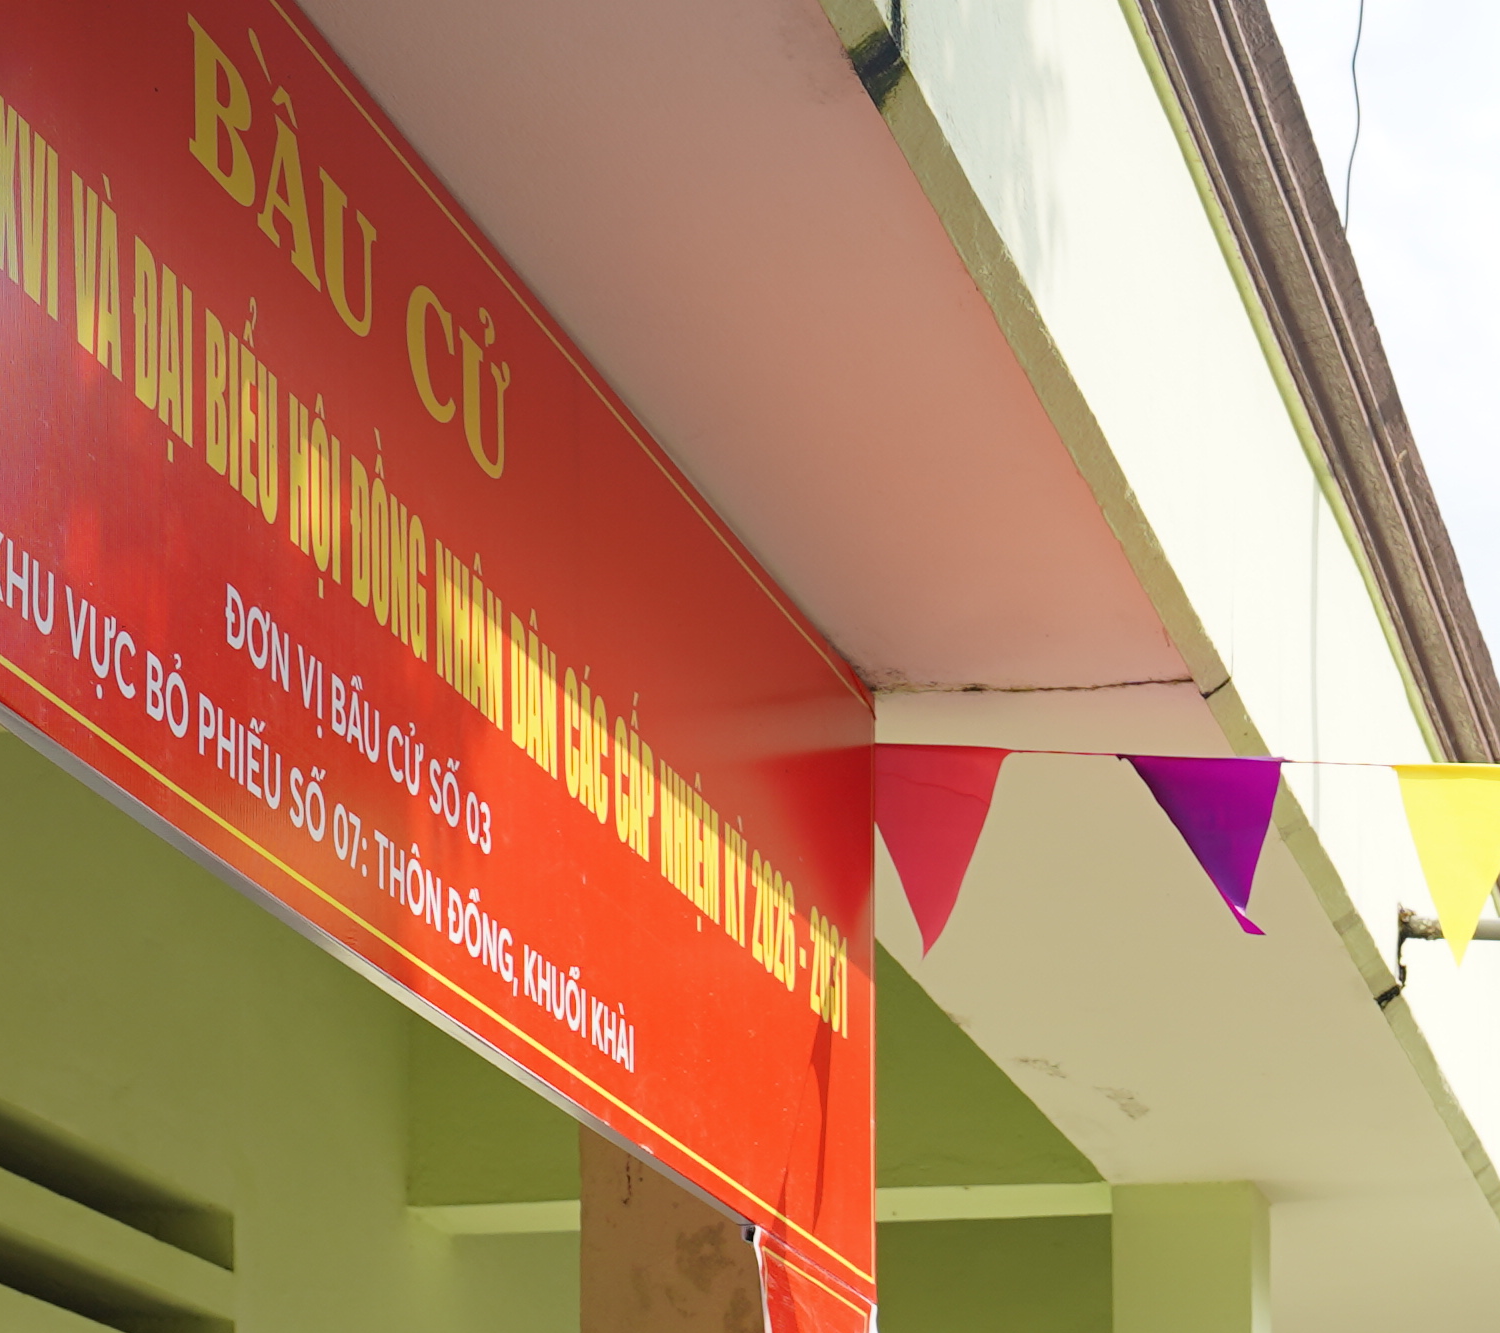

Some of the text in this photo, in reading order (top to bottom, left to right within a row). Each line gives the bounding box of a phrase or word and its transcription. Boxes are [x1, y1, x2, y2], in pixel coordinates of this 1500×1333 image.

[187, 12, 511, 479] BẦU CỬ
[65, 584, 136, 699] VỰC
[146, 650, 189, 738] BỎ
[198, 692, 281, 809] PHIẾU
[289, 766, 326, 842] SỐ
[333, 803, 367, 877] 07:
[374, 829, 442, 932] THÔN
[447, 886, 518, 996] ĐỒNG,
[523, 944, 586, 1039] KHUỔI
[591, 995, 634, 1073] KHÀI
[71, 170, 122, 382] VÀ
[133, 234, 193, 463] ĐẠI
[205, 297, 278, 525] BIỂU
[289, 392, 341, 599] HỘI
[350, 427, 427, 662] ĐỒNG
[435, 538, 504, 731] NHÂN
[510, 608, 558, 780] DÂN
[564, 664, 608, 824] CÁC
[614, 691, 654, 862] CẤP
[660, 758, 720, 932] NHIỆM
[724, 816, 747, 948] KỲ
[751, 849, 796, 992] 2026
[799, 946, 806, 969] -
[809, 905, 848, 1040] 2031
[225, 583, 491, 855] ĐƠN VỊ BẦU CỬ SỐ 03
